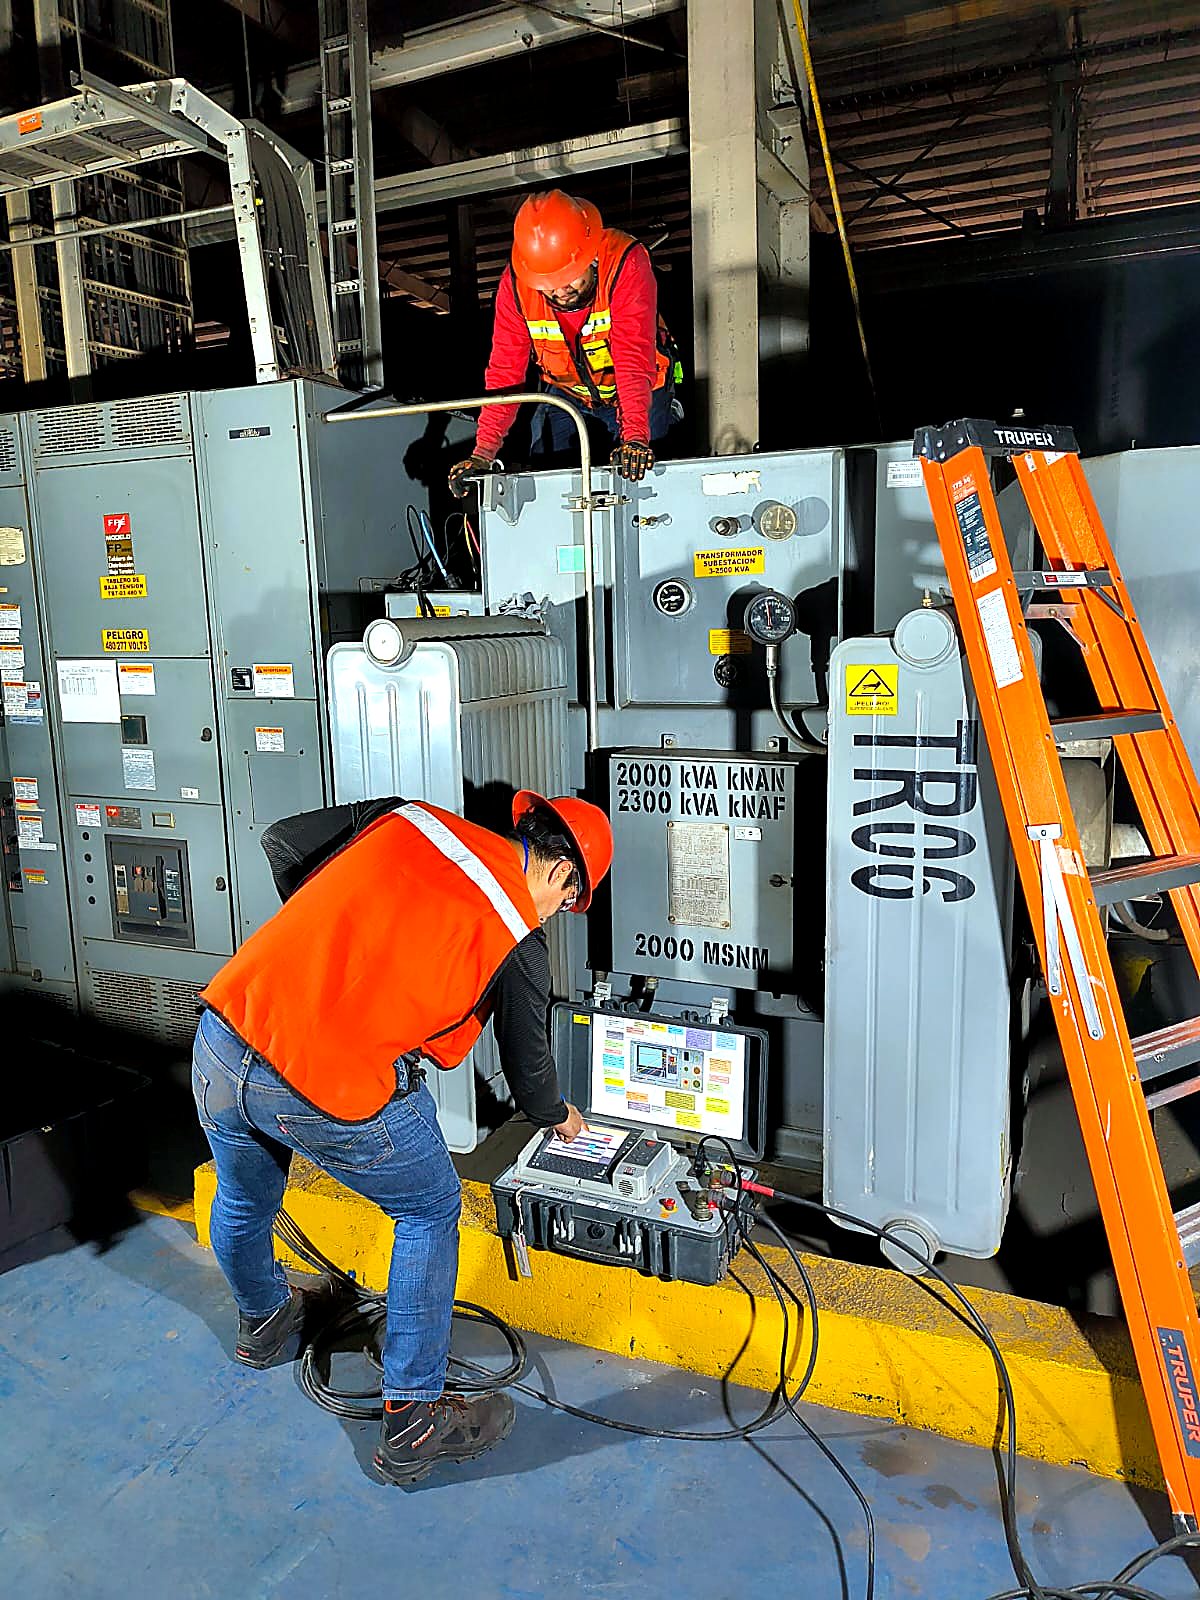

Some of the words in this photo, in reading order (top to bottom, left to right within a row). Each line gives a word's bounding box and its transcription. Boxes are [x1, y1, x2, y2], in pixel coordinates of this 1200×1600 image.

[993, 429, 1056, 447] TRUPER
[695, 549, 763, 560] TRANSFORMADOR
[703, 557, 756, 567] SUBESTACION
[708, 566, 733, 575] 3-2500
[734, 565, 750, 573] KVA
[106, 630, 144, 640] PELIGRO
[127, 640, 148, 650] VOLTS
[616, 762, 672, 788] 2000
[680, 765, 718, 790] kVA
[727, 766, 785, 792] kNAN
[618, 789, 672, 814] 2300
[680, 791, 719, 817] kVA
[728, 794, 786, 820] kNAF
[634, 933, 694, 961] 2000
[703, 941, 769, 970] MSNM
[1167, 1344, 1200, 1443] TRUPER
